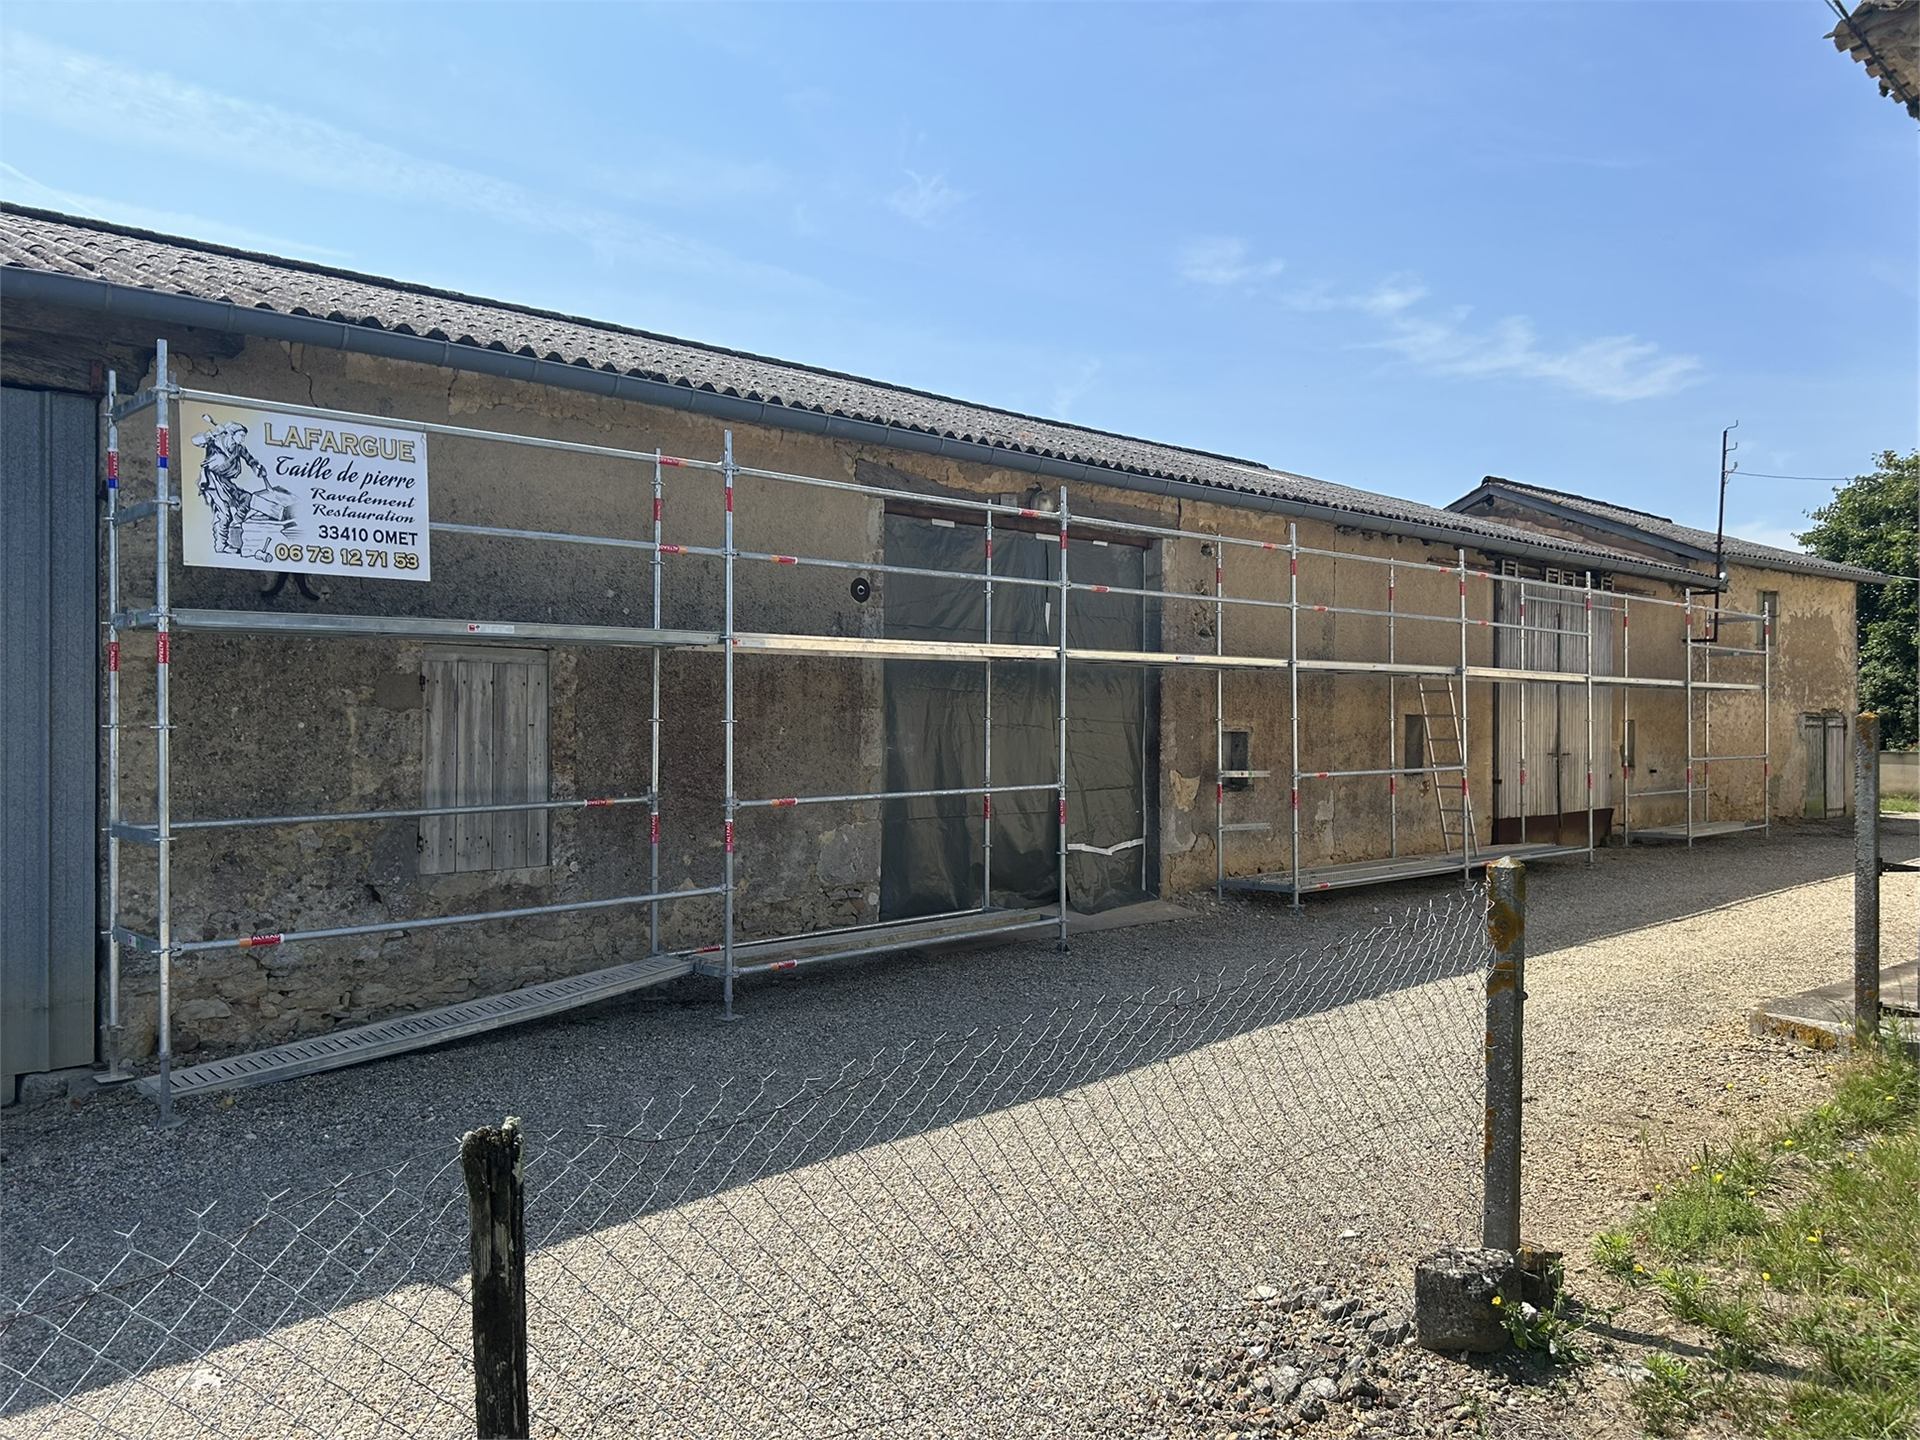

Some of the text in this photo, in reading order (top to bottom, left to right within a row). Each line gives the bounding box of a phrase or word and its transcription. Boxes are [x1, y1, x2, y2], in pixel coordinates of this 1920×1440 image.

[264, 422, 416, 463] LAFARGUE
[275, 455, 416, 489] Taille de pierre
[311, 487, 416, 508] Ravalement
[312, 503, 416, 524] Restauration
[318, 525, 418, 546] 33410 OMET
[275, 543, 420, 569] 06 73 12 71 53
